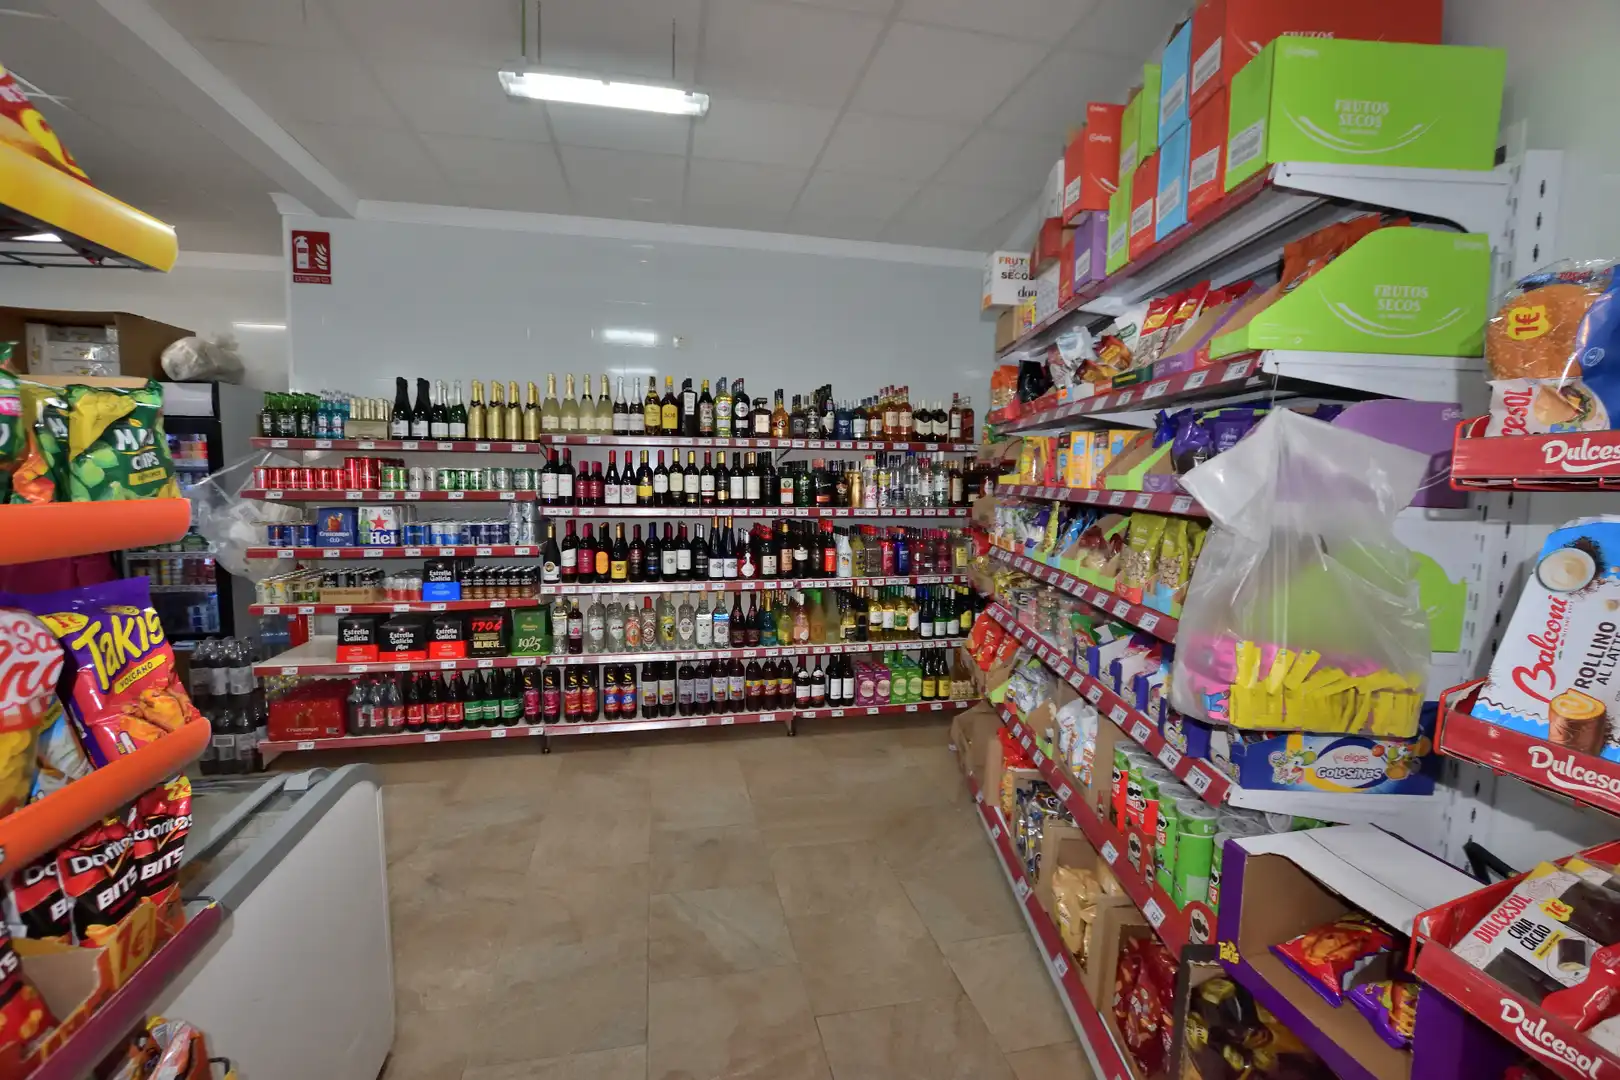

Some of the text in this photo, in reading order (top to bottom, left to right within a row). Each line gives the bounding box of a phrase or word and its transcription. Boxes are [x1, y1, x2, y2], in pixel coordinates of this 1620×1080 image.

[1335, 99, 1389, 115] FRUTOS
[1338, 114, 1382, 128] SECOS
[1374, 285, 1429, 298] FRUTOS
[1377, 298, 1422, 312] SECOS
[1541, 438, 1620, 465] Dulces
[471, 618, 503, 632] 1906
[71, 607, 165, 690] Takis
[518, 636, 542, 652] 1925
[1573, 621, 1617, 689] ROLLINO
[119, 661, 153, 689] VOLCANO
[1595, 671, 1613, 686] AL
[1528, 745, 1620, 794] Dulceso
[140, 845, 185, 881] BITS
[97, 865, 138, 911] BITS
[1519, 924, 1552, 951] CACAO
[1500, 998, 1604, 1080] Dulcesol
